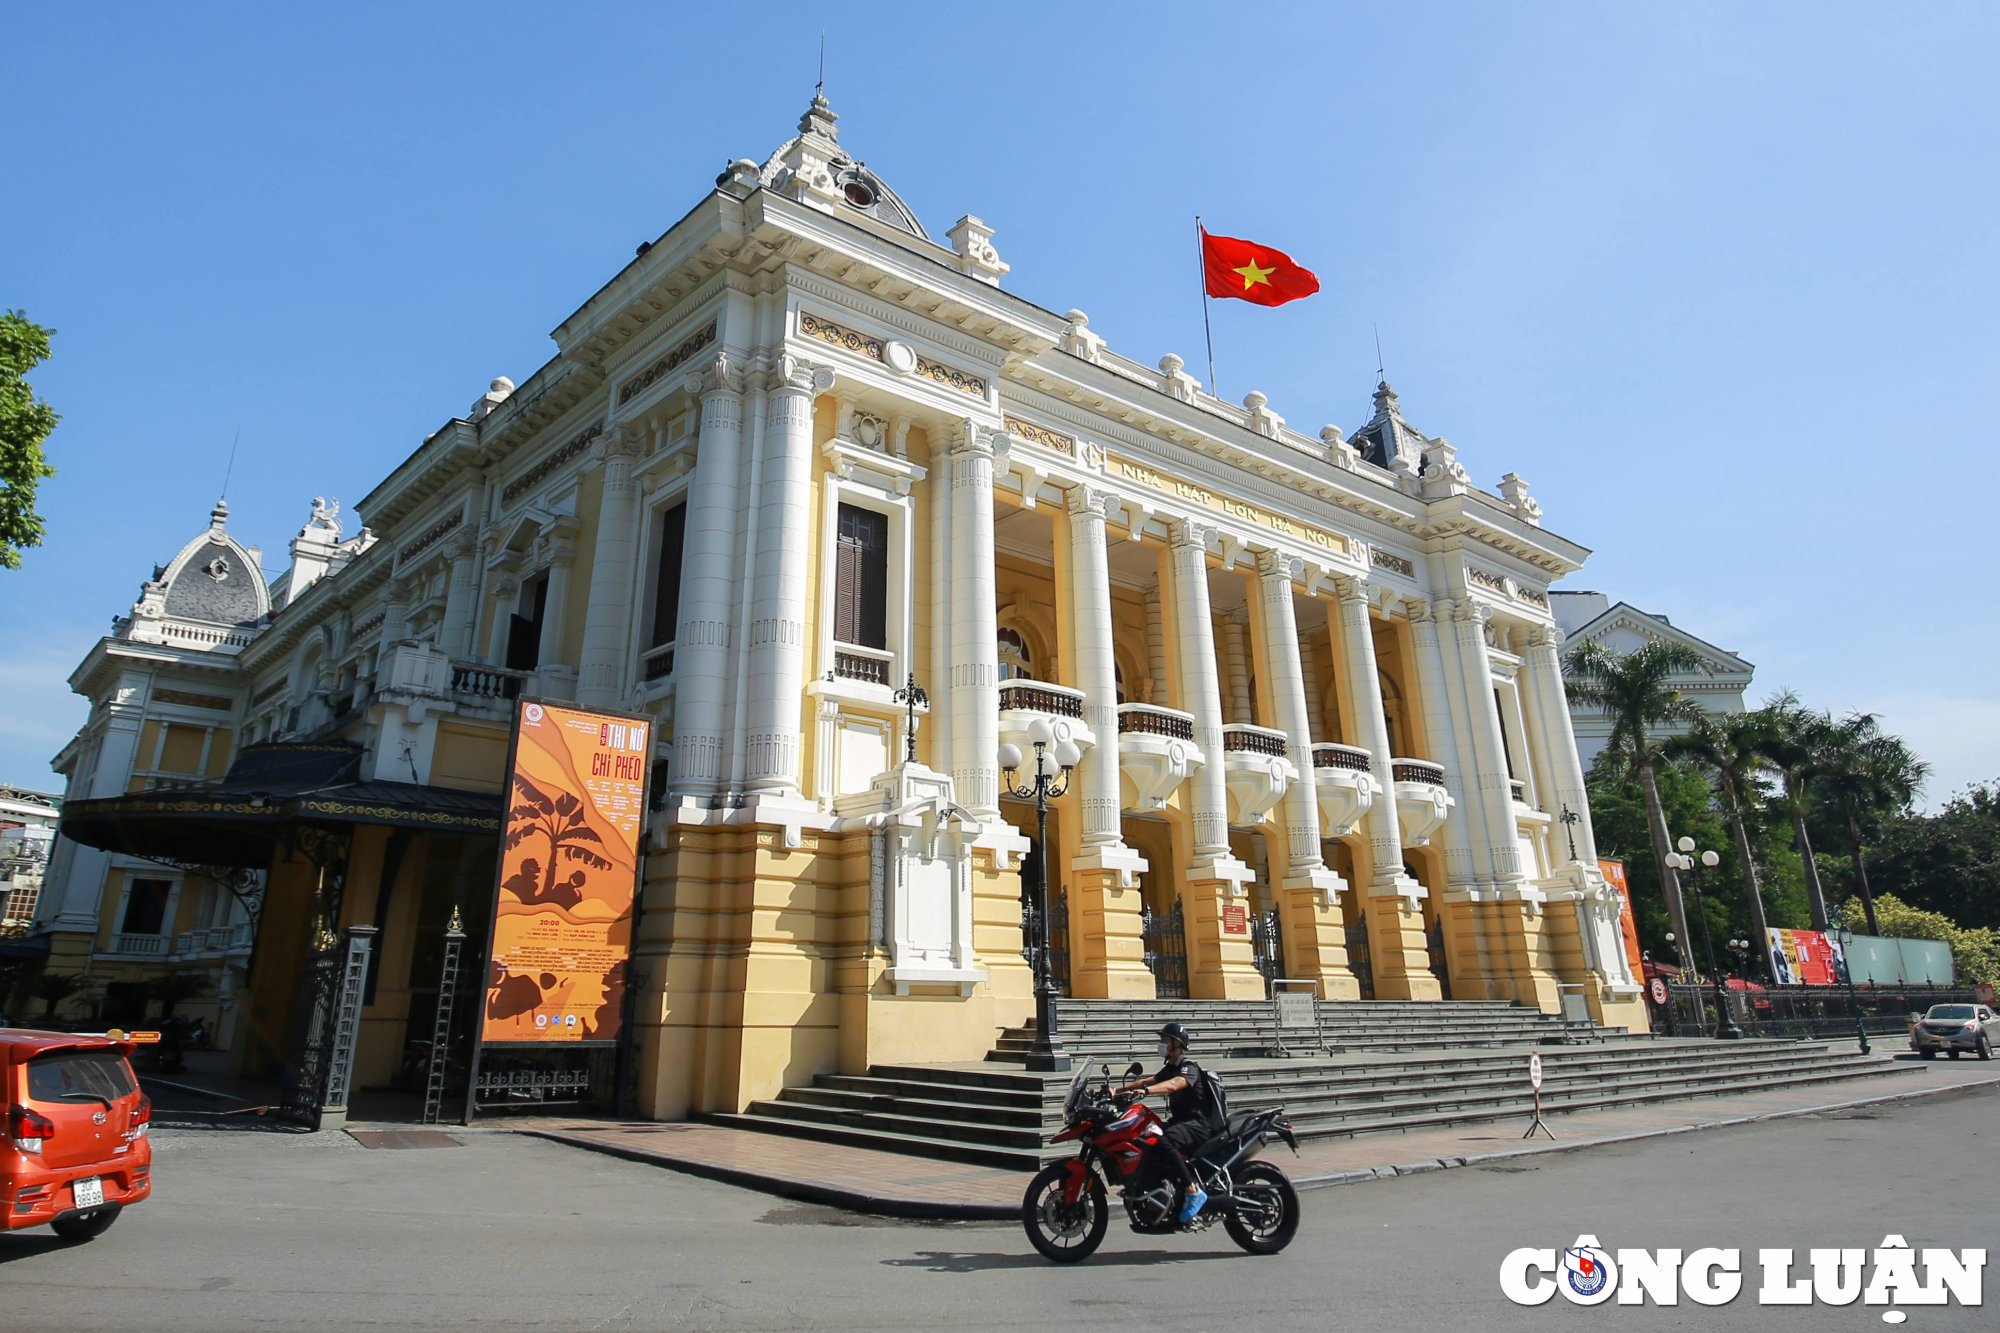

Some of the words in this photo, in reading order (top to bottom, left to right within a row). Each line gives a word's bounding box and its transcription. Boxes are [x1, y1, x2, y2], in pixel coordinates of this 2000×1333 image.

[1122, 463, 1162, 489] NHÀ
[1176, 483, 1211, 505] HÁT
[1271, 516, 1294, 535] HÀ
[608, 723, 626, 752] THỊ
[629, 722, 646, 752] NỞ
